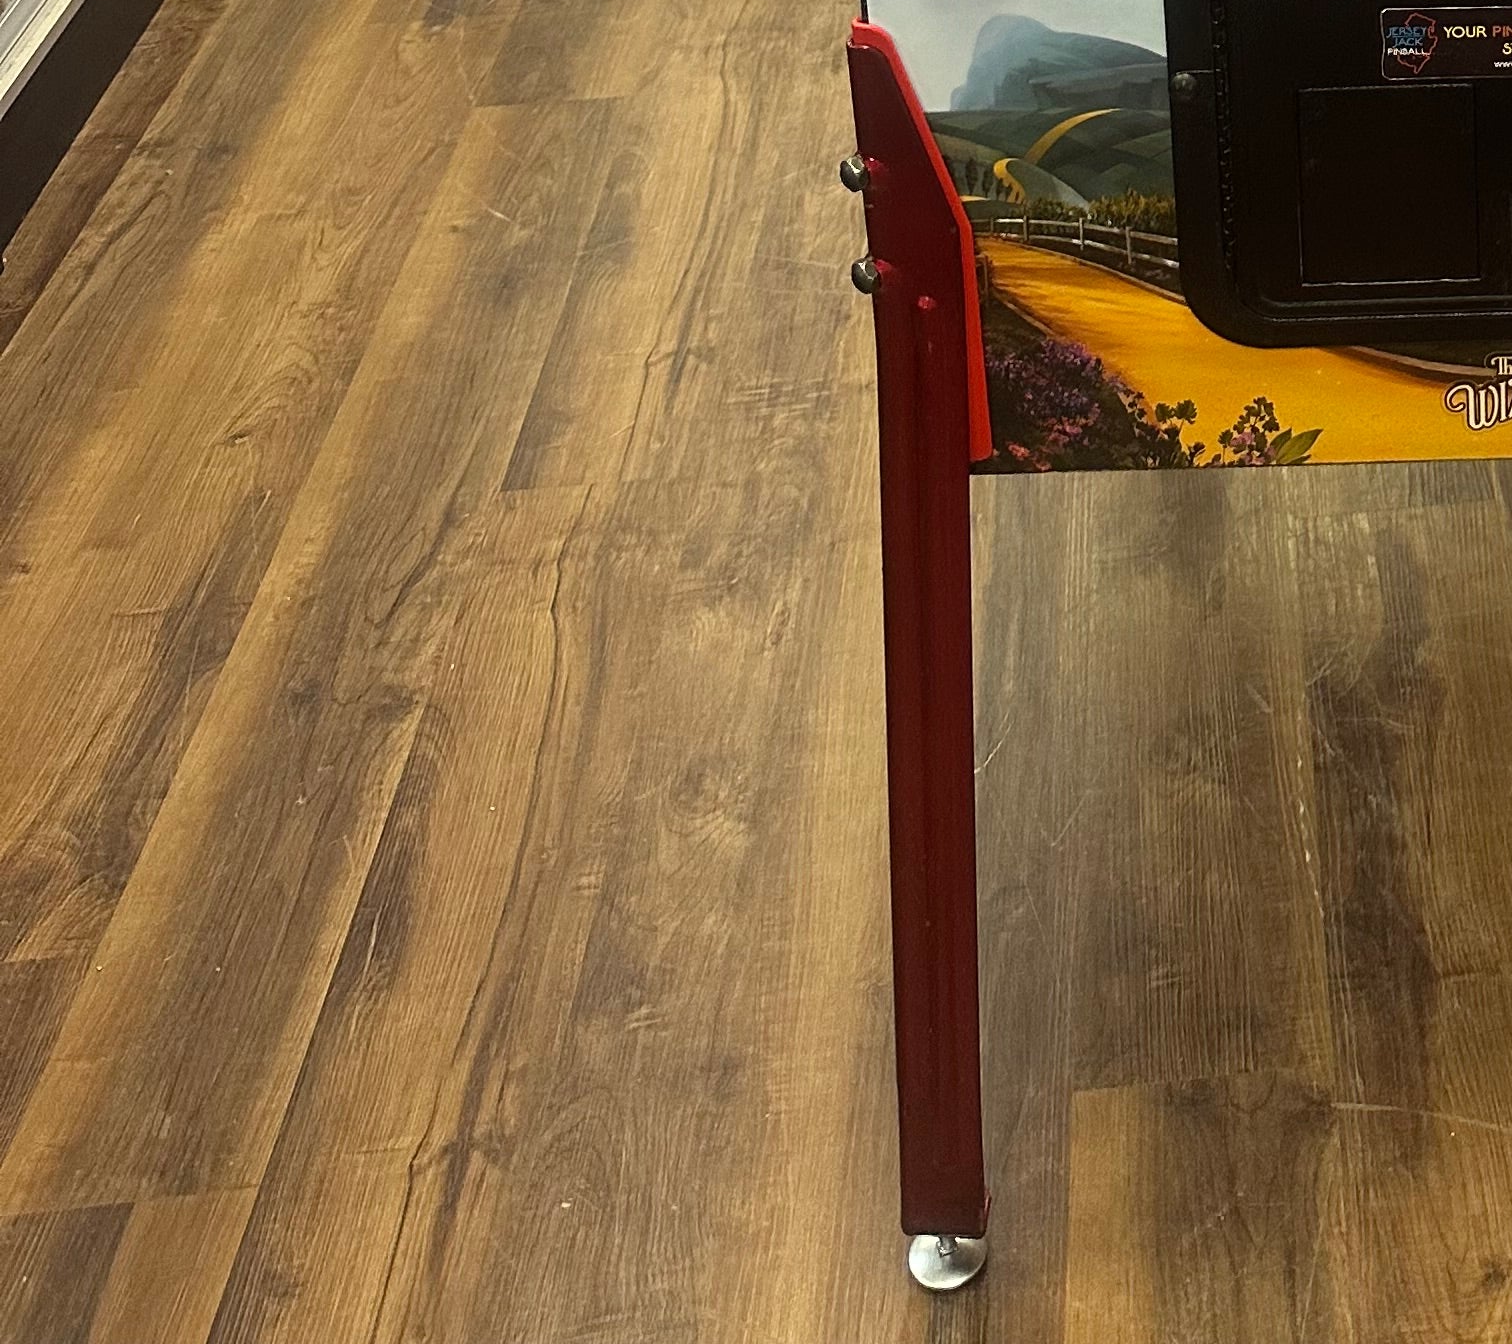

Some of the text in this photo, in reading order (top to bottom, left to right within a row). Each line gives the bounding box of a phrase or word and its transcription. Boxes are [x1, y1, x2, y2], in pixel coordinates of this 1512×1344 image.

[1386, 26, 1428, 38] JERSEY
[1443, 25, 1487, 38] YOUR
[1391, 37, 1424, 48] JACK
[1387, 48, 1428, 56] PINBALL
